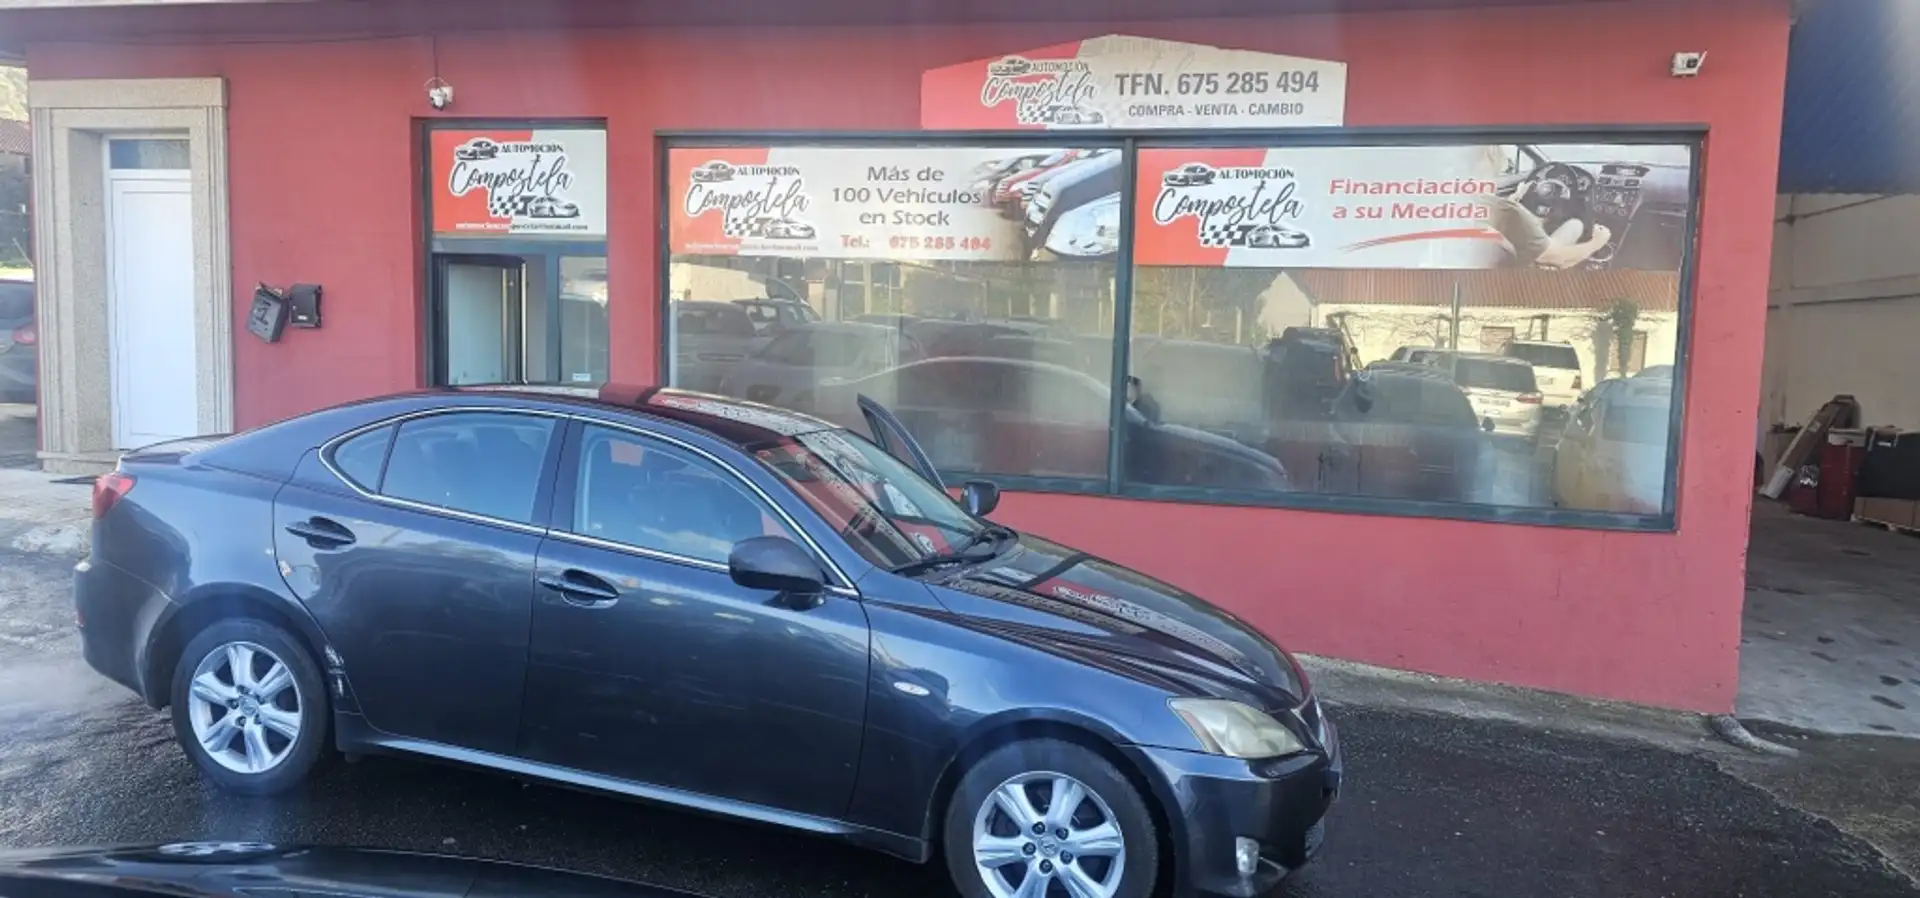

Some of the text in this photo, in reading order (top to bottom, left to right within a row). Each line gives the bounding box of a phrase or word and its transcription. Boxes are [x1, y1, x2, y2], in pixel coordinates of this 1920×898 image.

[984, 70, 1097, 111] Compostela
[1115, 70, 1319, 96] TFN. 675 285 494
[1128, 105, 1185, 117] COMPRA
[1195, 104, 1238, 116] VENTA
[1248, 103, 1304, 116] CAMBIO
[451, 154, 573, 202] Compostela
[867, 165, 945, 182] Más de
[1218, 168, 1295, 179] AUTOMOCIÓN
[1329, 177, 1496, 195] Financiación
[686, 176, 810, 223] Compostela
[832, 187, 982, 205] 100 Vehículos
[1155, 180, 1304, 232] Compostela
[1332, 202, 1489, 219] a su Medida
[859, 210, 950, 226] en Stock
[889, 235, 920, 249] 675
[923, 235, 955, 250] 285
[959, 236, 991, 251] 494
